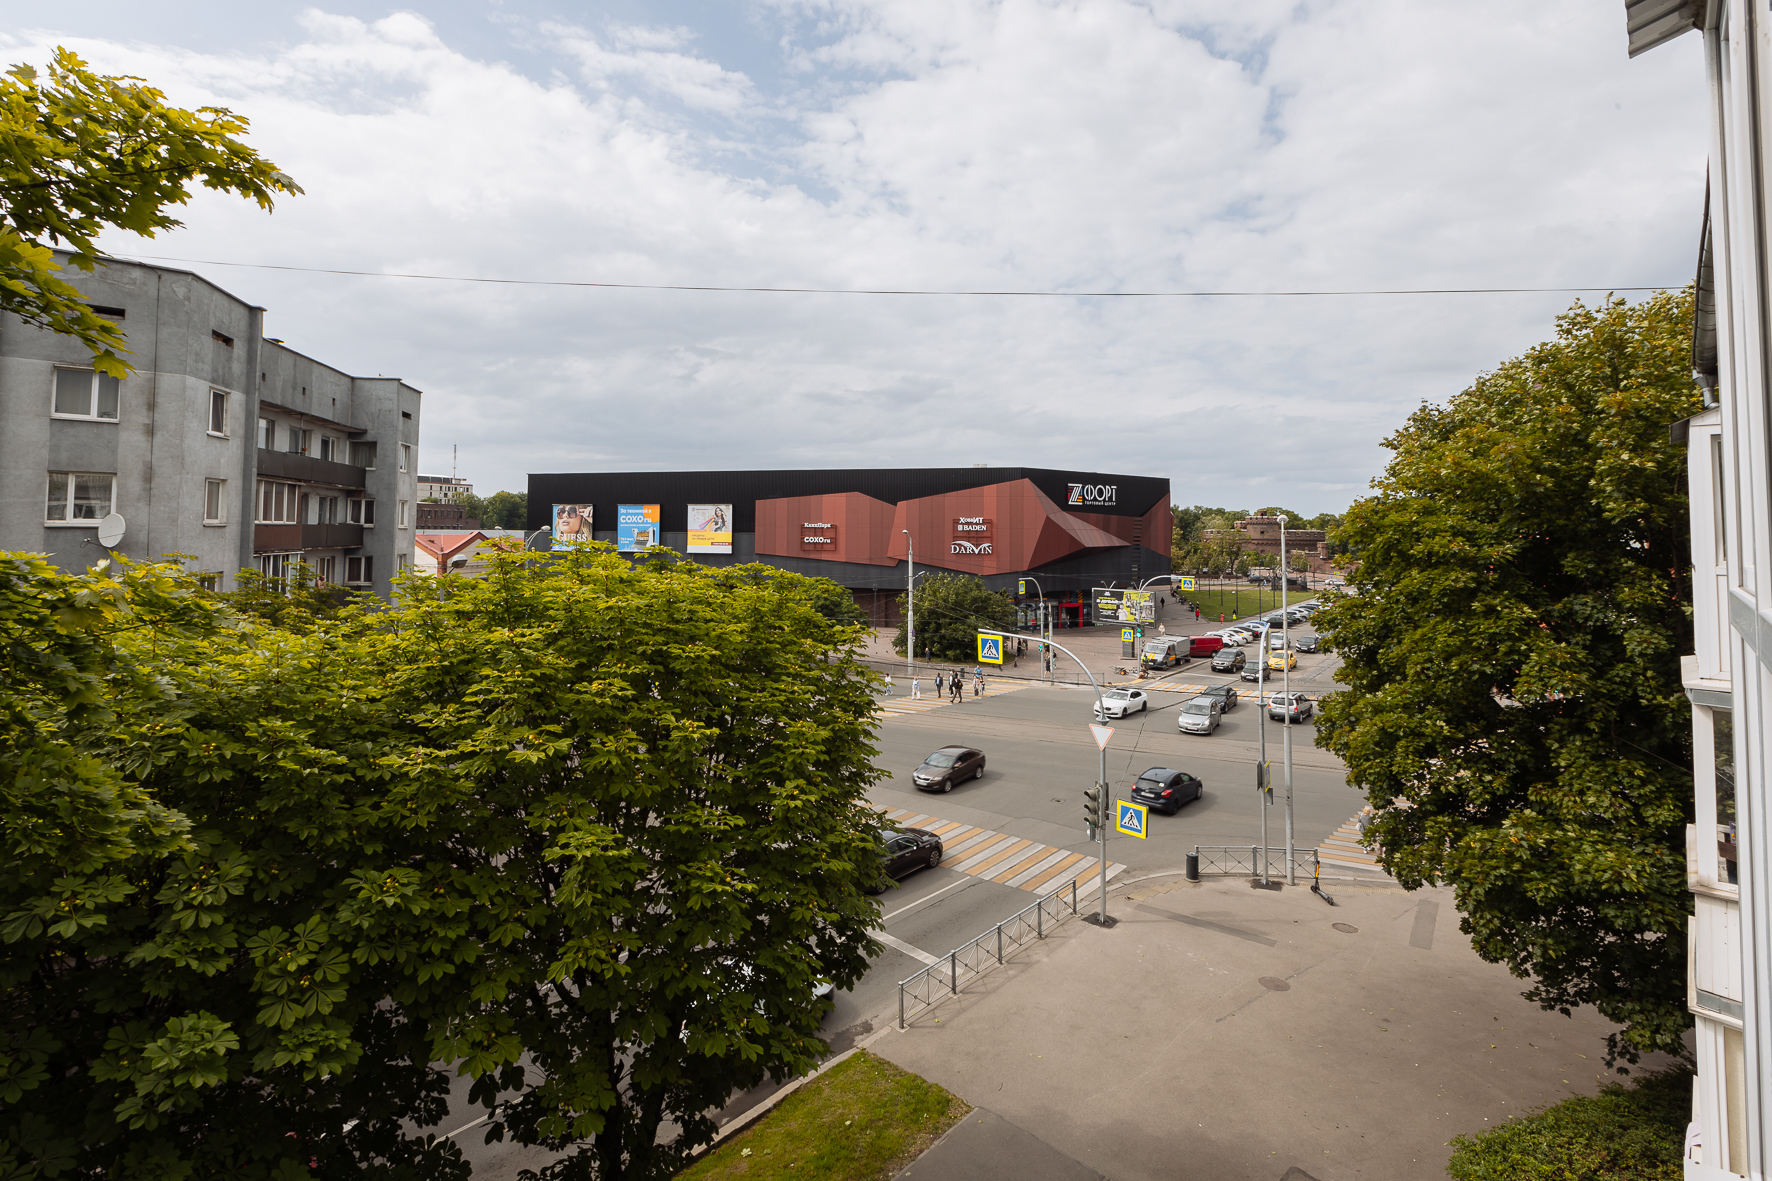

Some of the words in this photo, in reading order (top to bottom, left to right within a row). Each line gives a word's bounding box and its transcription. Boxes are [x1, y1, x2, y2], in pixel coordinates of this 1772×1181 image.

[1084, 485, 1117, 501] ФОРТ
[557, 533, 587, 542] GUESS
[951, 541, 993, 554] DARVIN
